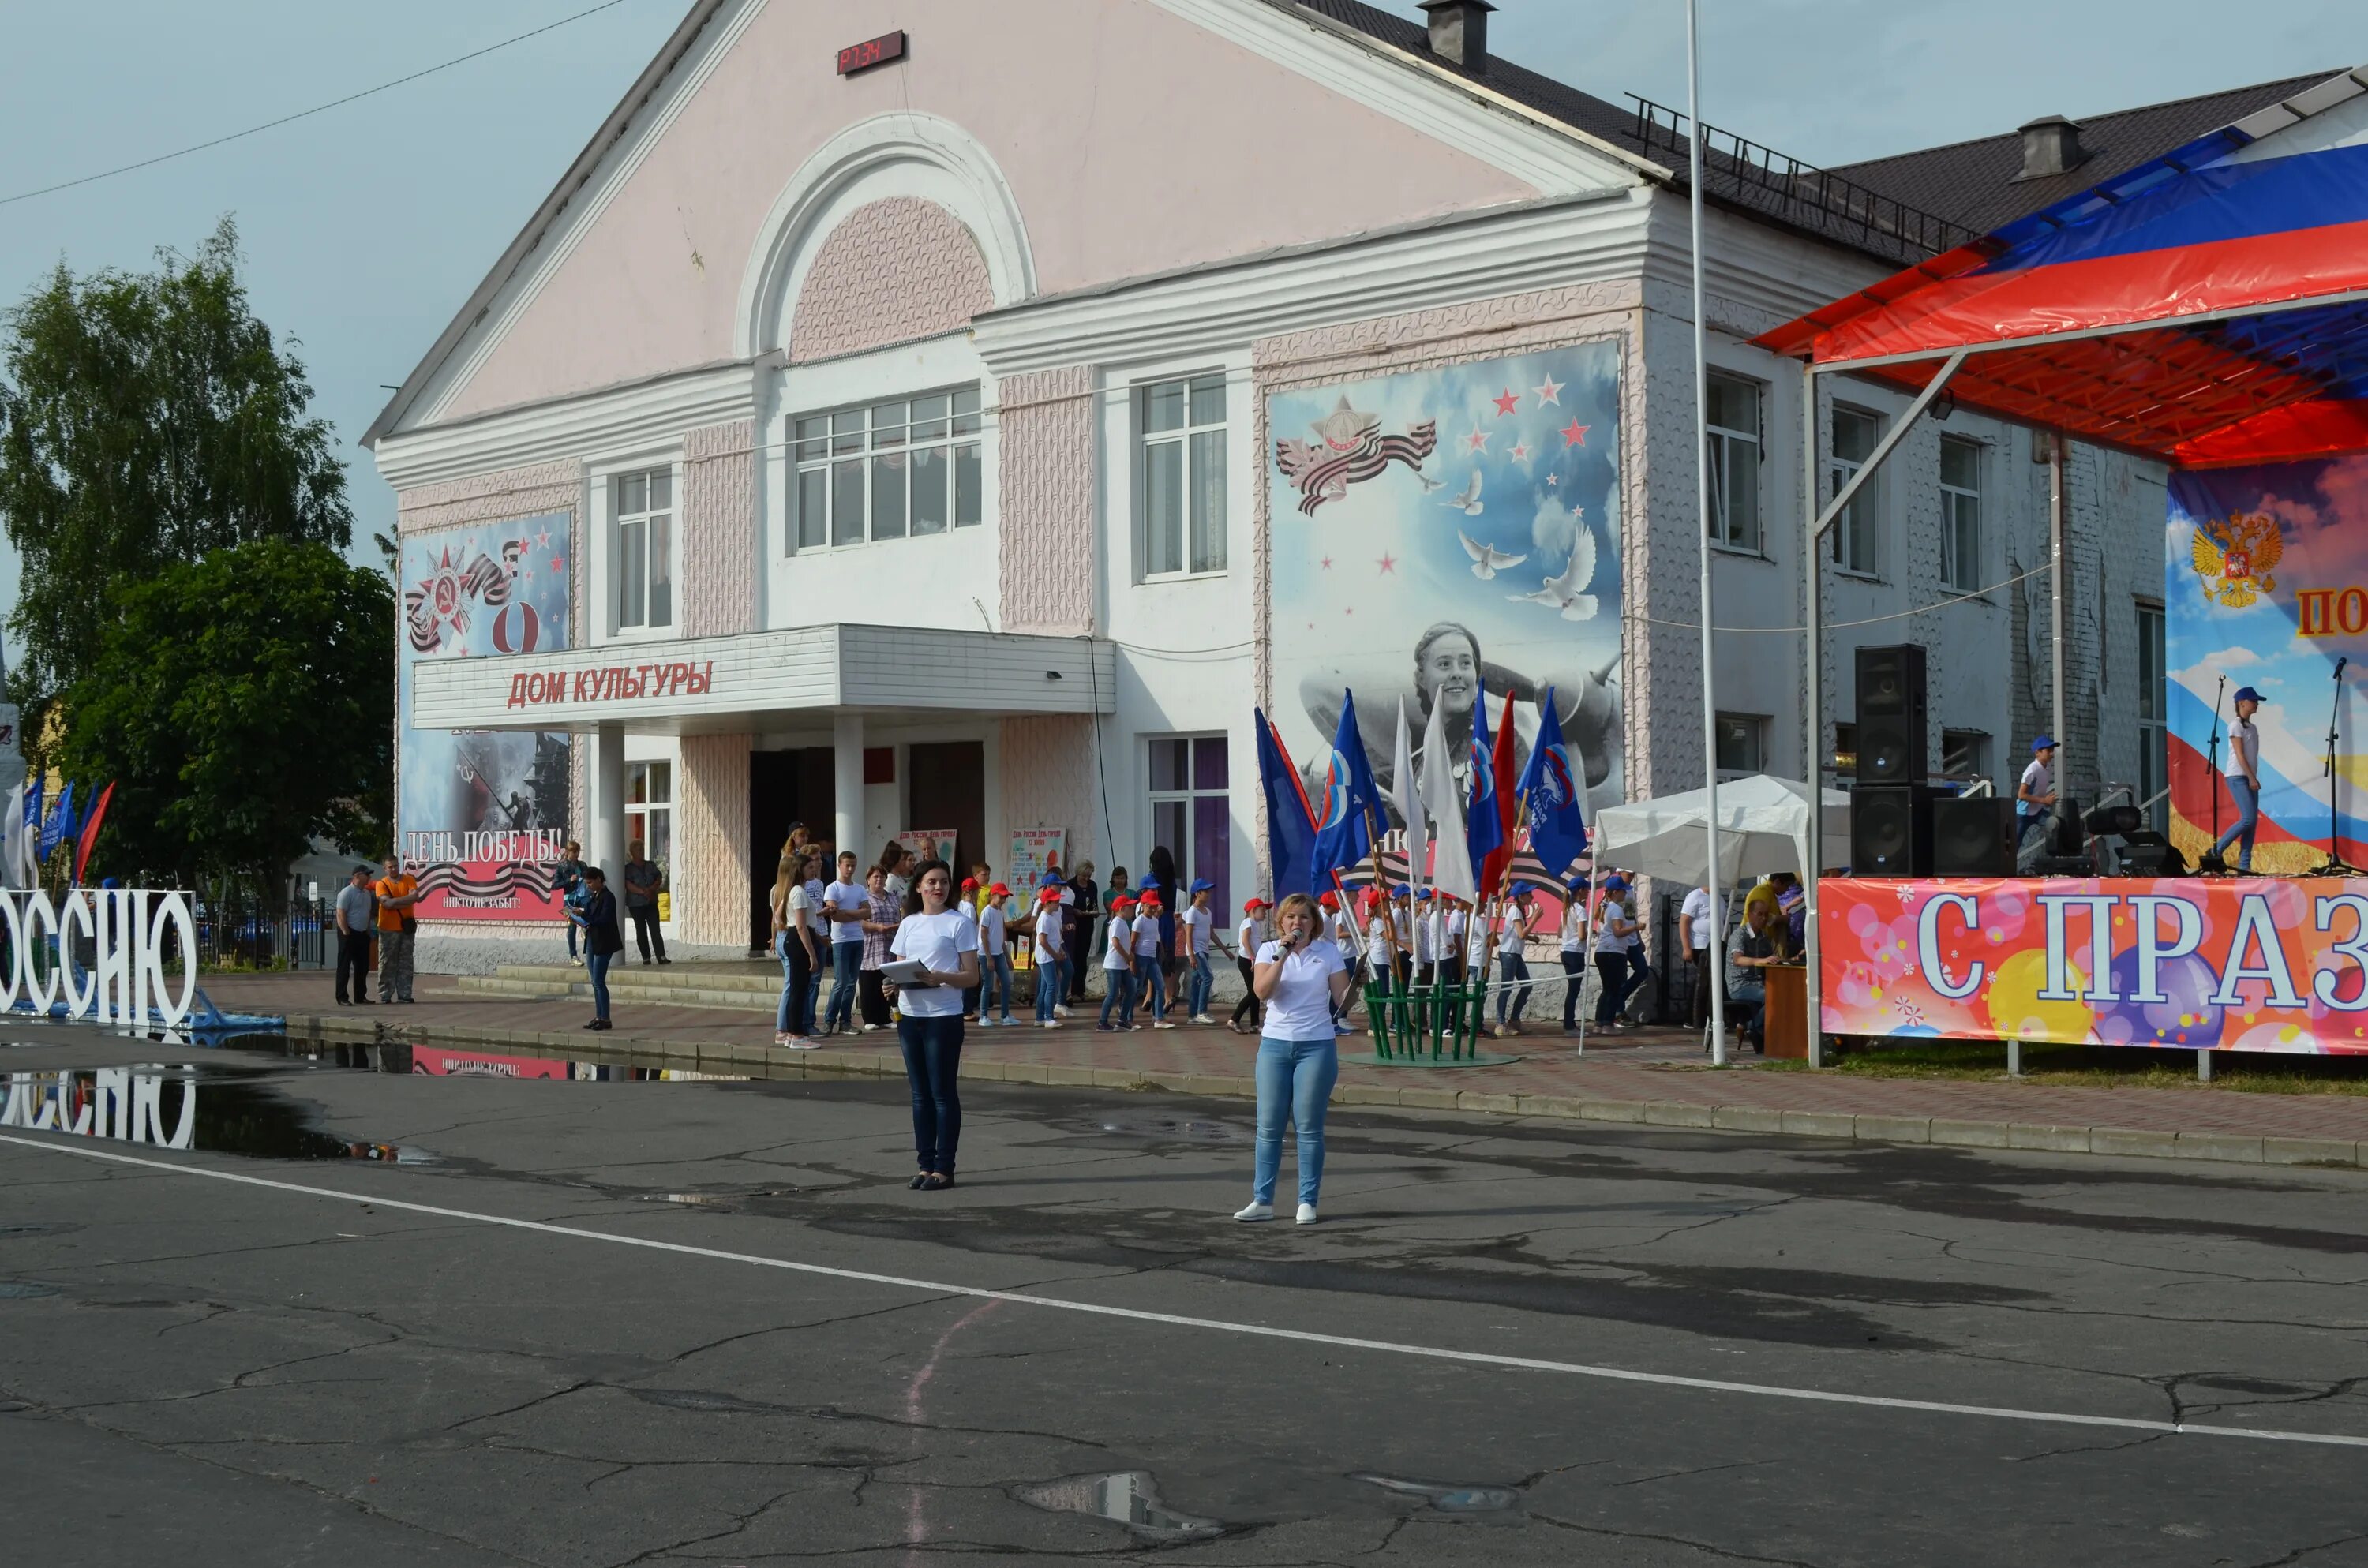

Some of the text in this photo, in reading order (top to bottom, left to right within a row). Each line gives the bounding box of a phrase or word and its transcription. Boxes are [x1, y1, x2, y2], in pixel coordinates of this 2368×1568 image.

[508, 660, 714, 709] ДОМ КУЛЬТУРЫ
[403, 829, 562, 870] ДЕНЬ ПОБЕДЫ!
[443, 896, 521, 908] НИКТО НЕ ЗАБЫТ!
[1917, 893, 2368, 1011] С ПРАЗ
